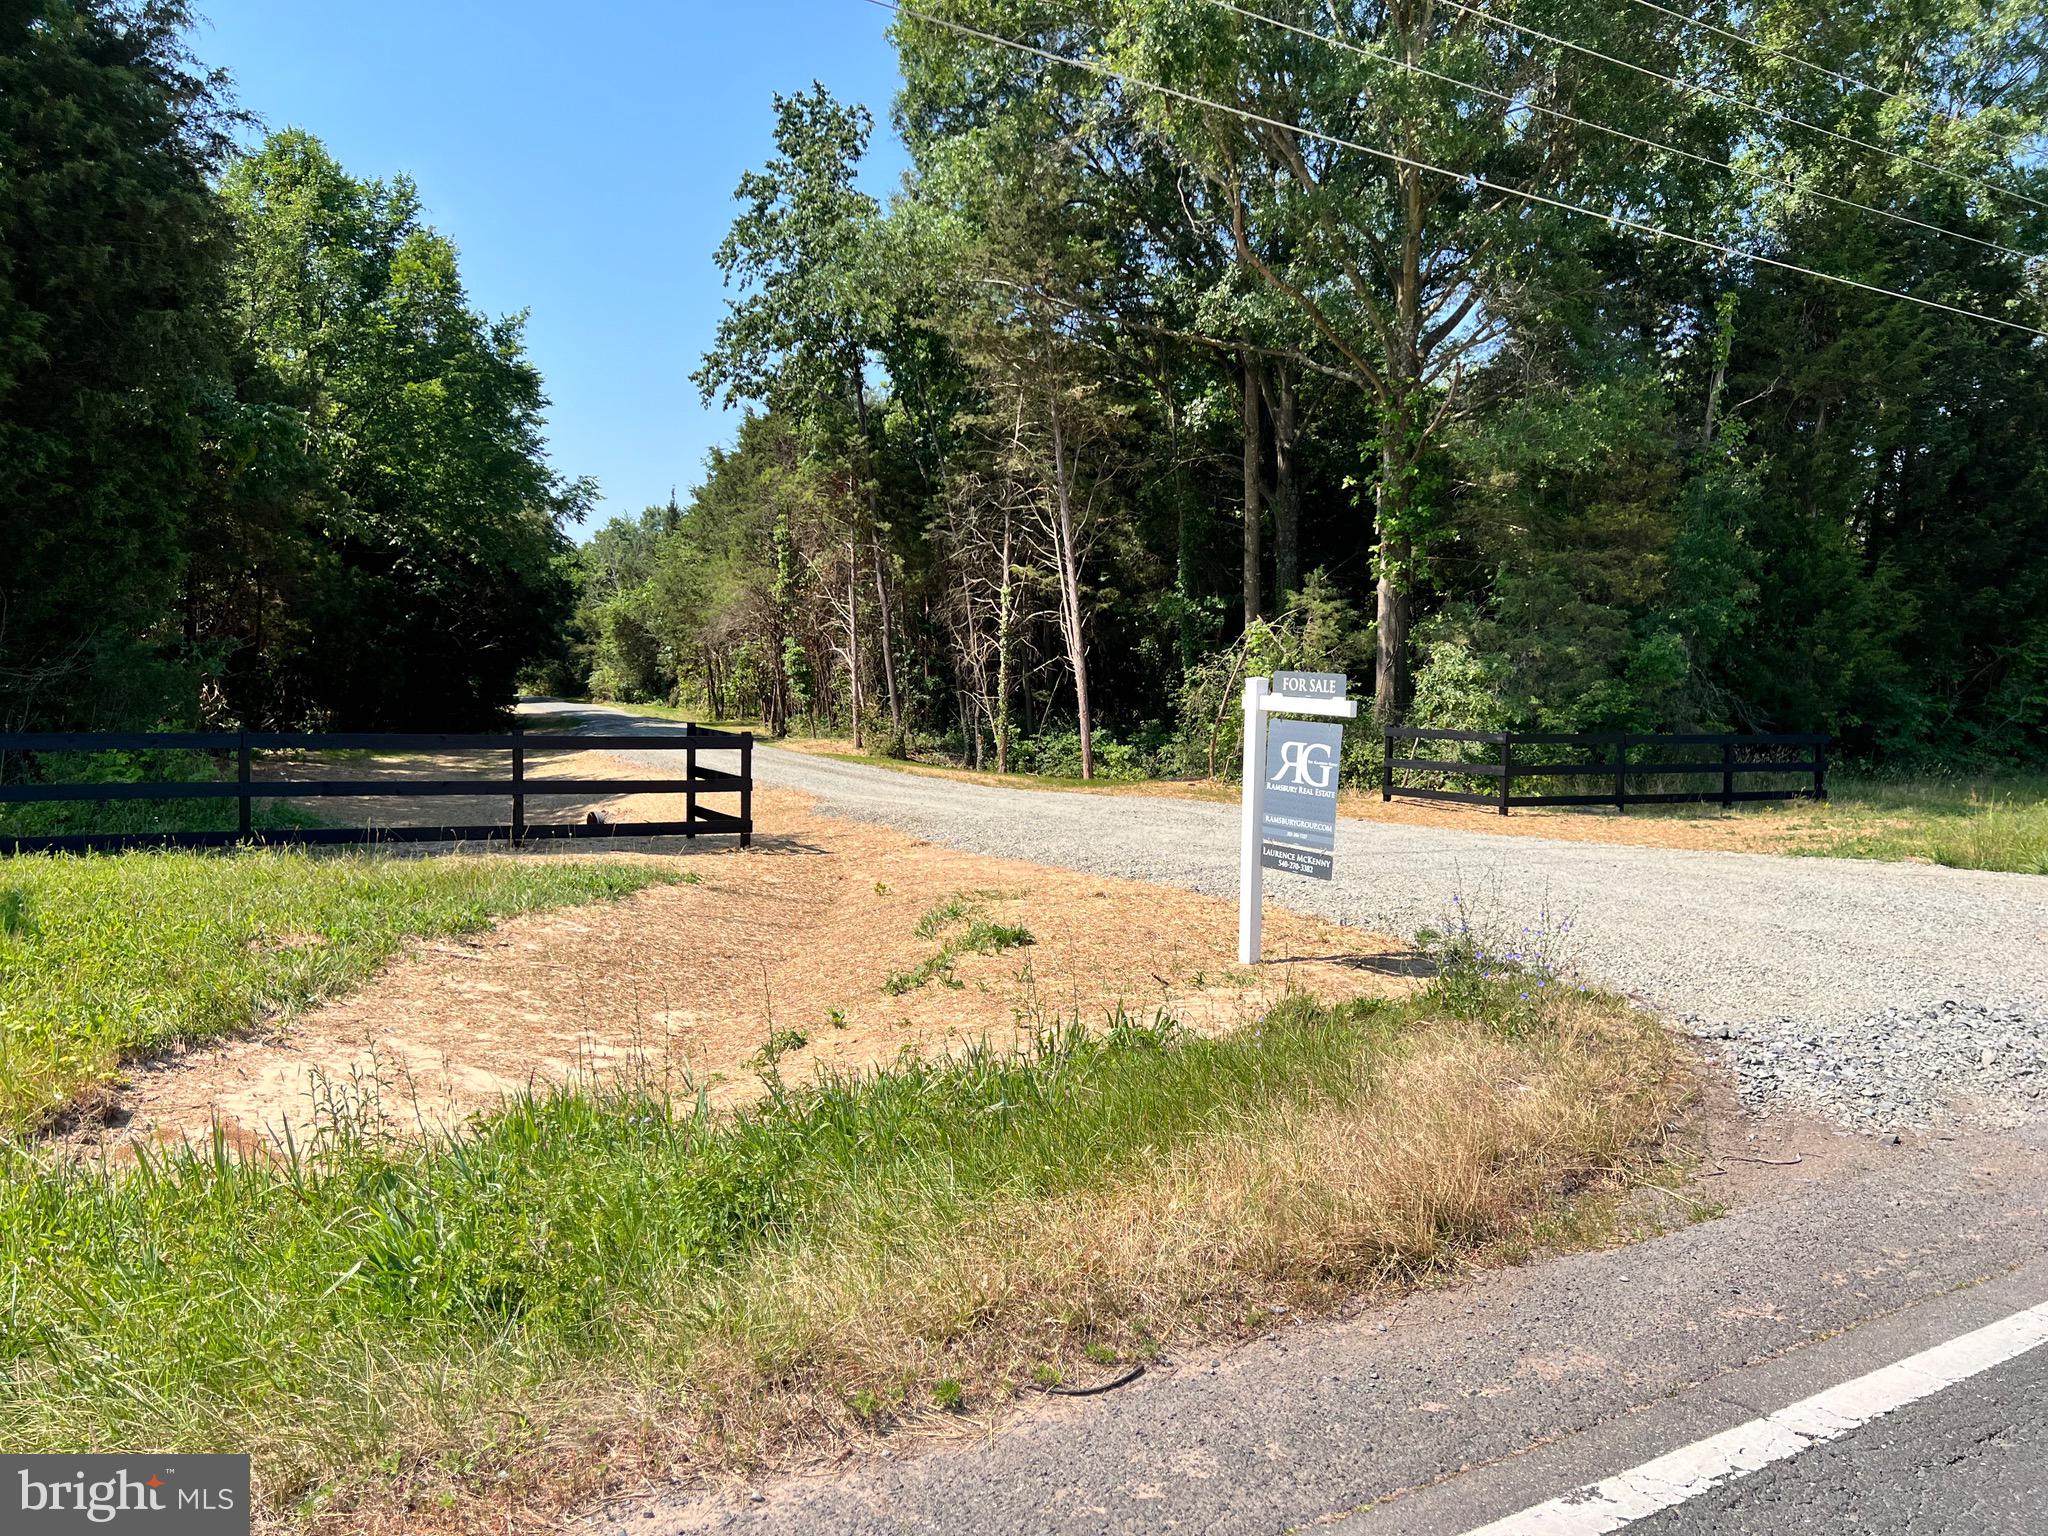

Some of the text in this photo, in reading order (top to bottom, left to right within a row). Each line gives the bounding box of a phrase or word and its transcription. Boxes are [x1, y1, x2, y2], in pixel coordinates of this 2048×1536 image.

[1283, 677, 1336, 694] FOR SALE
[1298, 785, 1314, 796] REAL
[1315, 788, 1336, 799] ESTATE
[1265, 815, 1333, 833] RAMSBURYGROUP.COM
